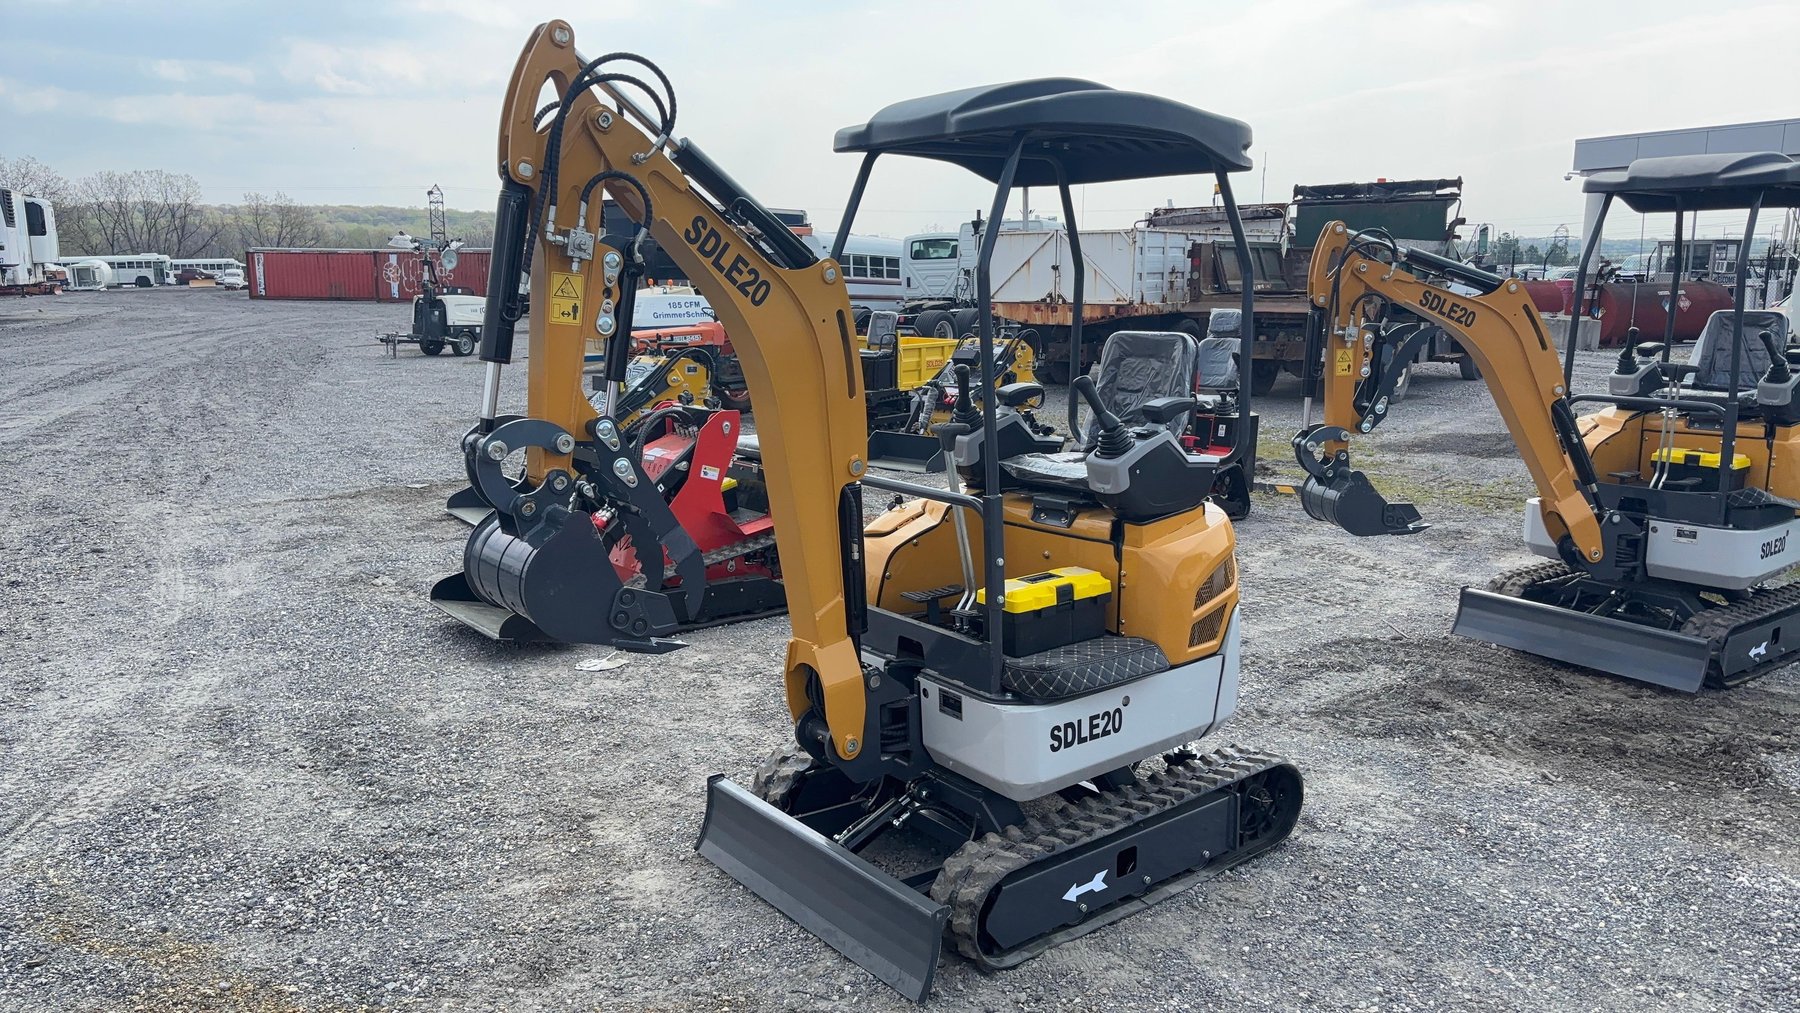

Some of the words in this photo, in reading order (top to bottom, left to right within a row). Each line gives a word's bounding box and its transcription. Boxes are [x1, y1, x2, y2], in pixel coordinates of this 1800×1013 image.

[684, 215, 771, 307] SDLE20
[652, 310, 715, 319] GrimmerSchmid
[667, 301, 683, 309] 185
[684, 301, 701, 309] CFM
[1419, 289, 1477, 328] SDLE20
[1760, 535, 1787, 560] SDLE20
[1049, 707, 1123, 753] SDLE20
